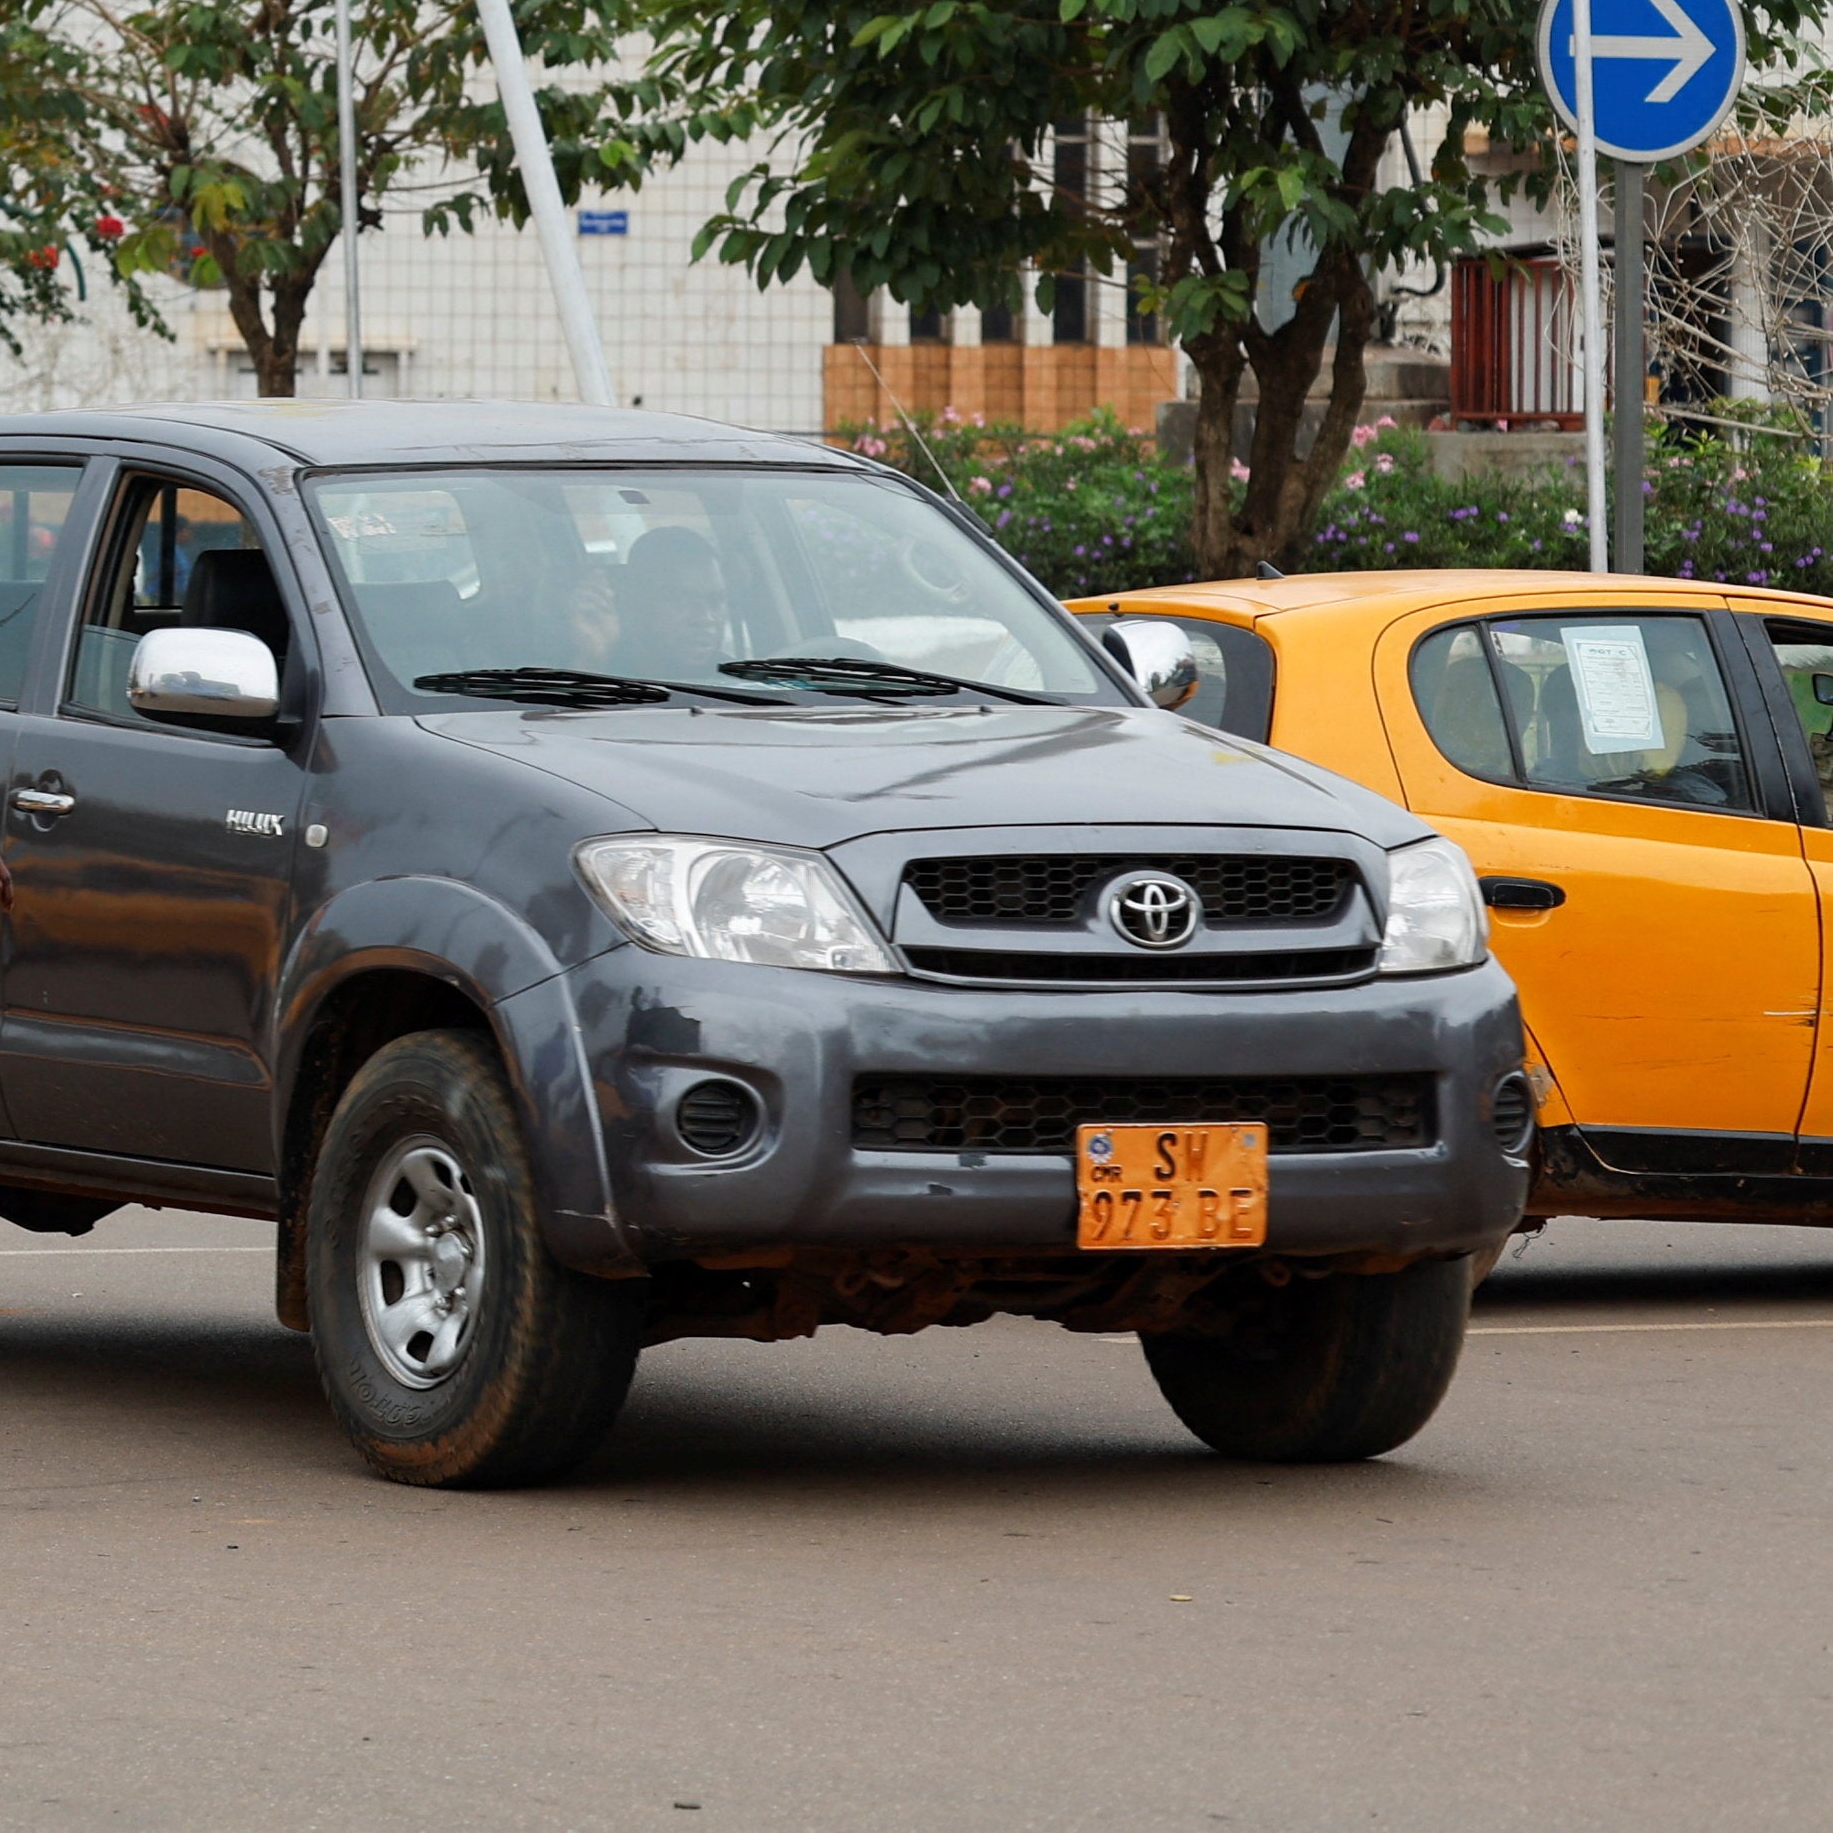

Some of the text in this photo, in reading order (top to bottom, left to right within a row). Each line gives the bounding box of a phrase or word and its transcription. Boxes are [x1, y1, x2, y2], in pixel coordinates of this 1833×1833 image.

[225, 809, 285, 836] HILUX
[1153, 1131, 1210, 1183] SW
[1091, 1188, 1254, 1241] 973 BE
